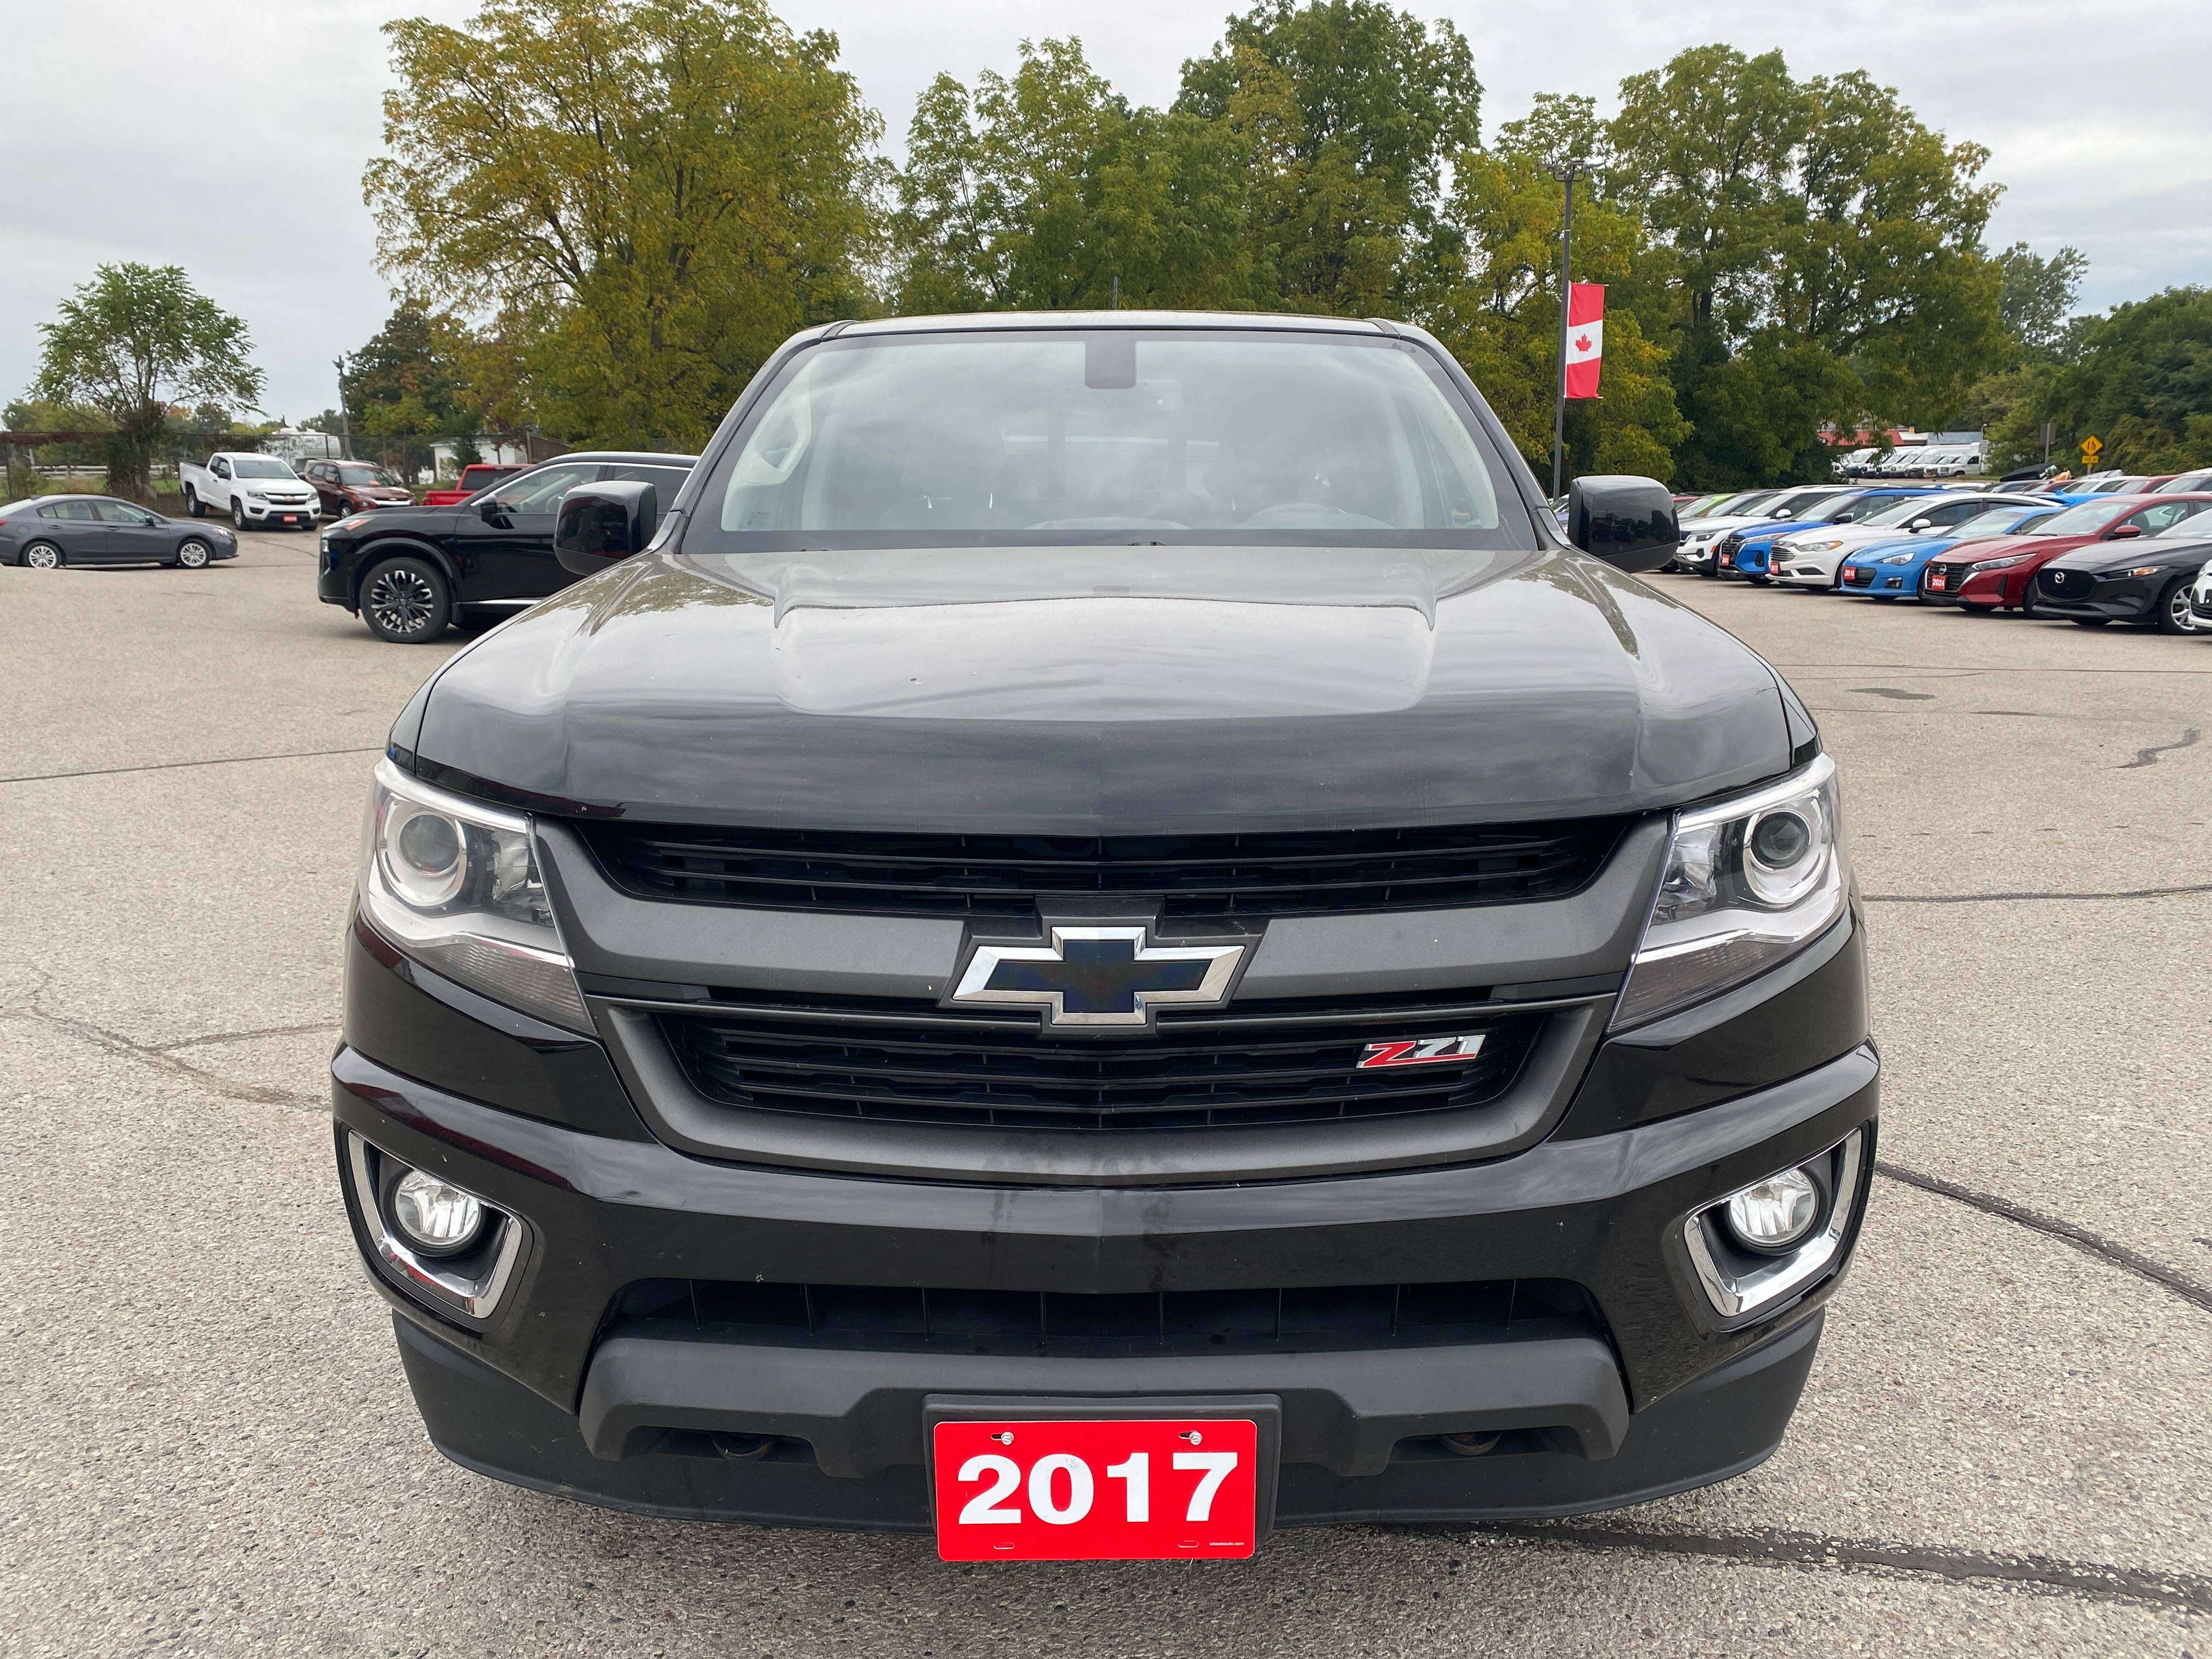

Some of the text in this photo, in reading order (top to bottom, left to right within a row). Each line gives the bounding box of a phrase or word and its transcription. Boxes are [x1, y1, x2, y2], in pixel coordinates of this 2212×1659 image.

[1932, 578, 1945, 587] 2024
[1356, 1035, 1486, 1068] Z71
[958, 1452, 1238, 1525] 2017
